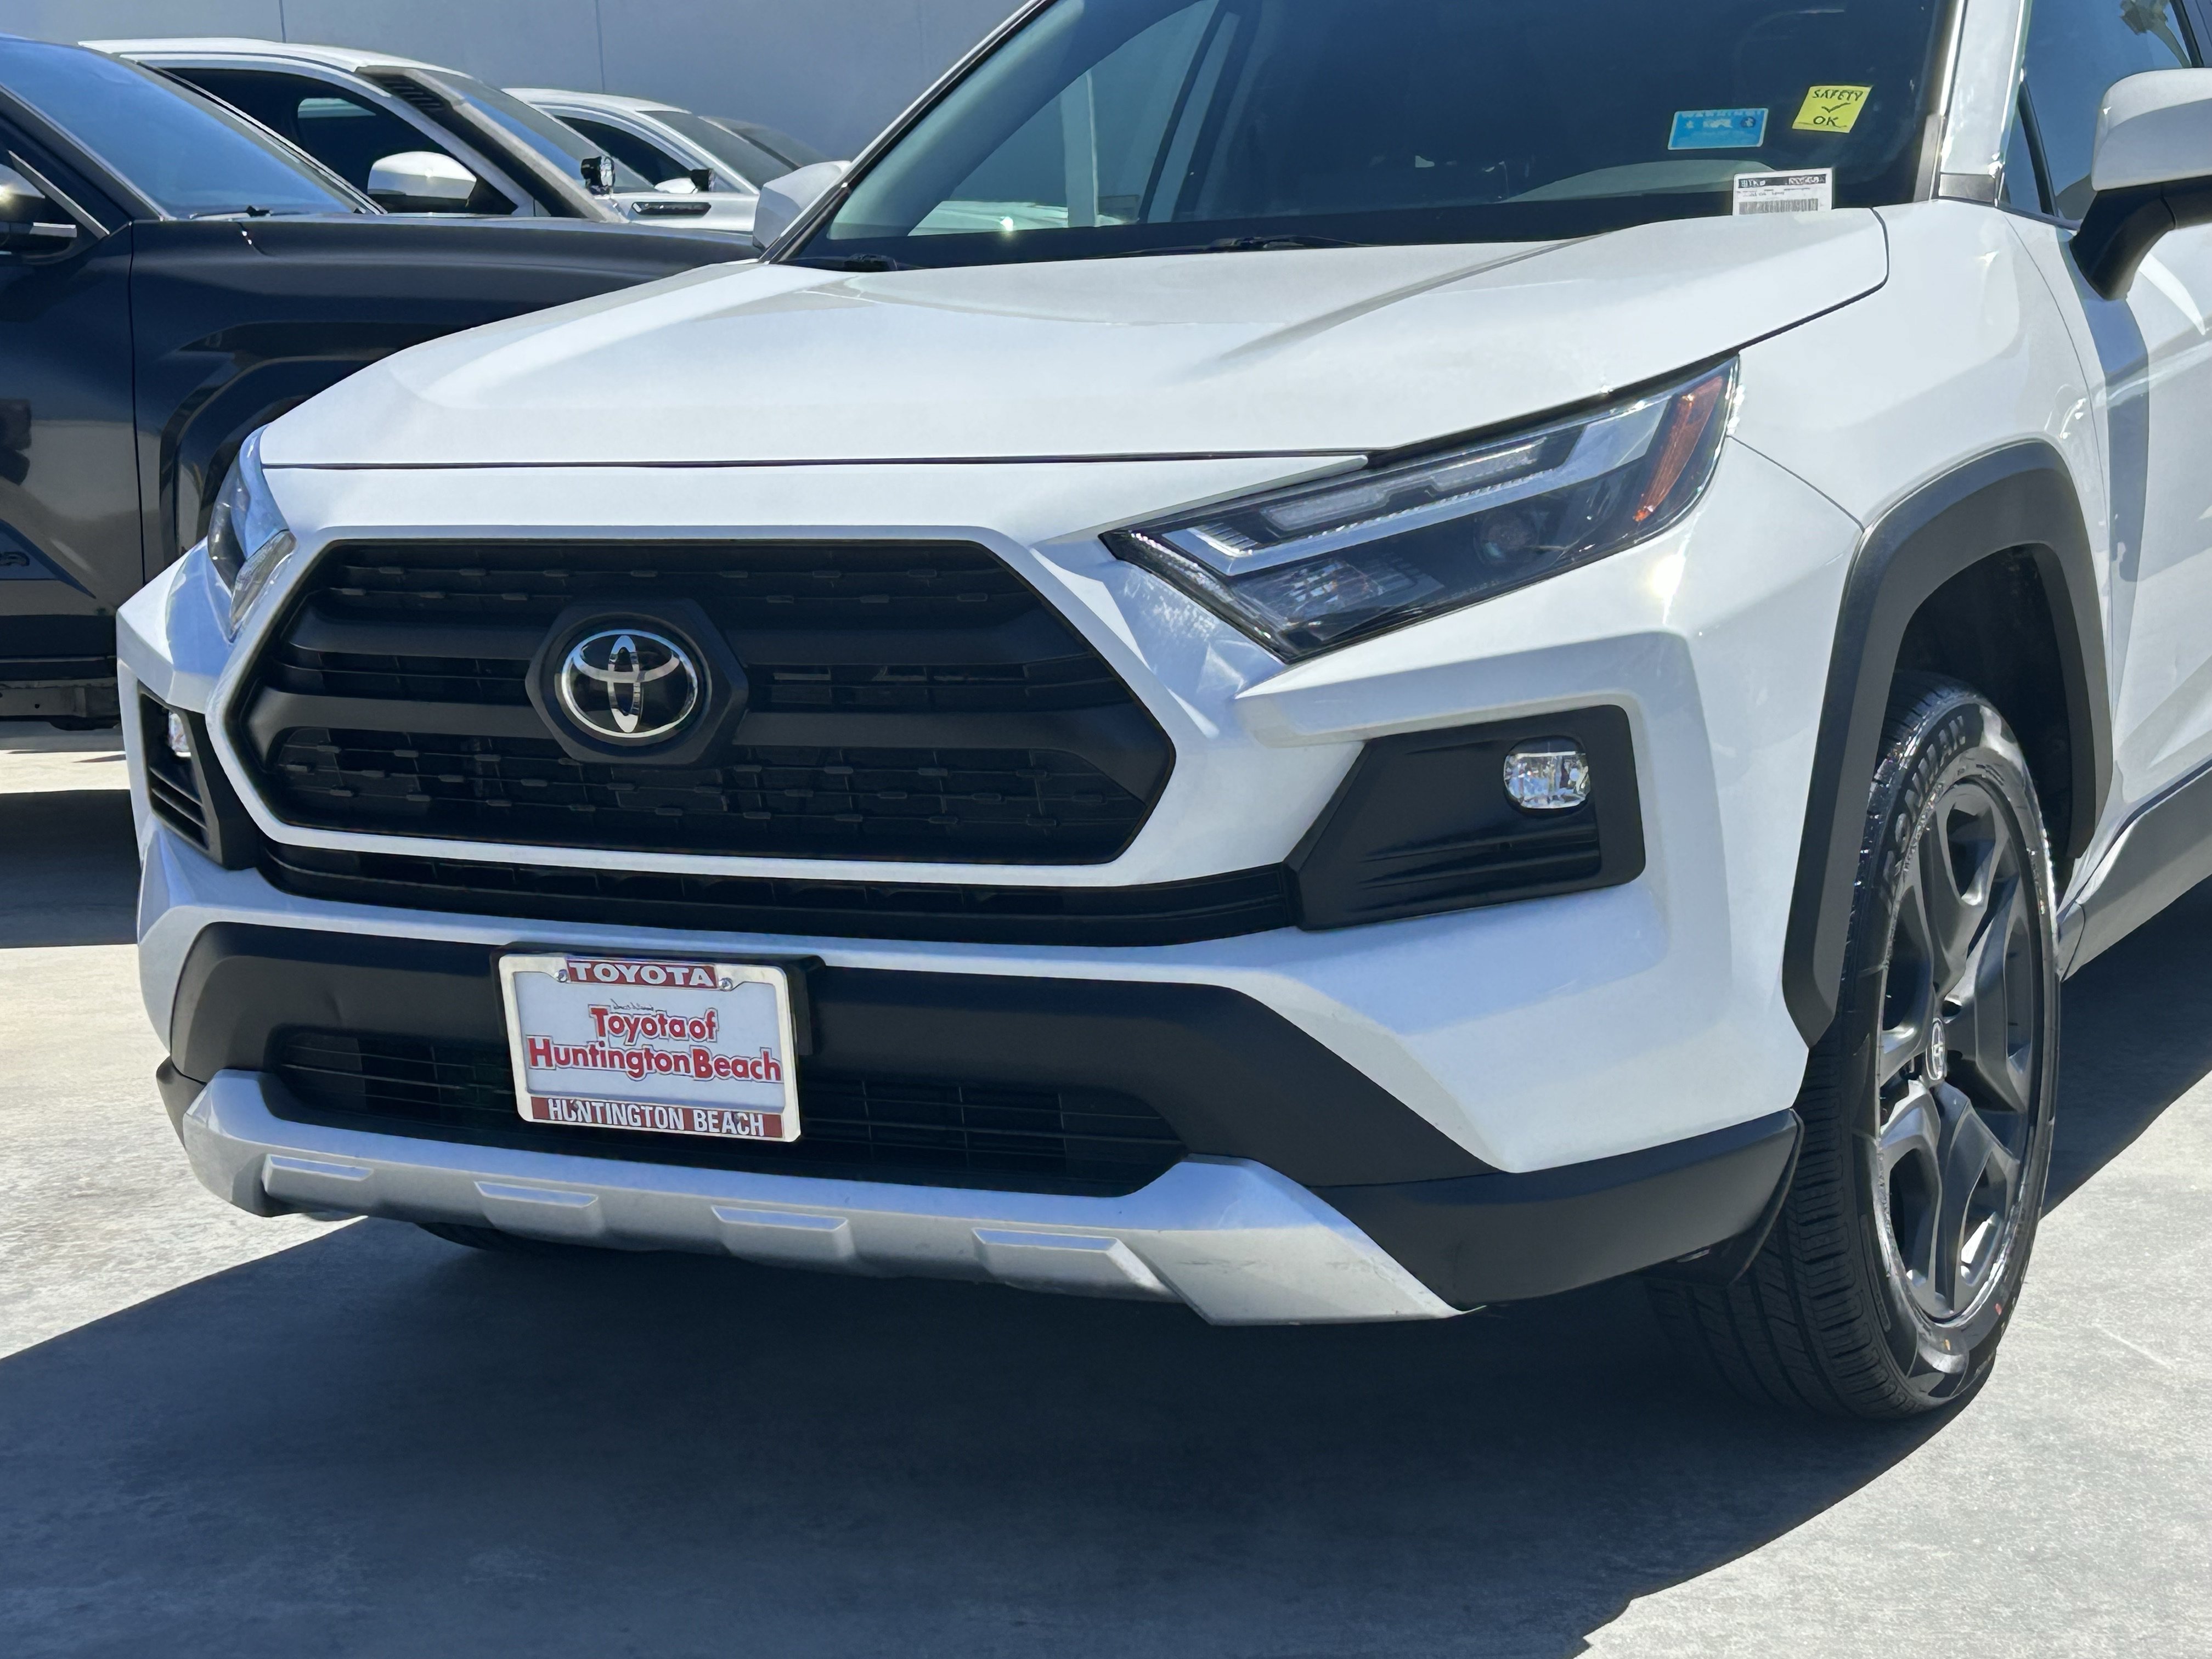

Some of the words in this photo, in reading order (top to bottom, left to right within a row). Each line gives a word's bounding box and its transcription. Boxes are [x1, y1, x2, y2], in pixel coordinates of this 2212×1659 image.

[1812, 89, 1864, 101] SAFETY
[1813, 115, 1843, 128] OK
[569, 962, 714, 987] TOYOTA
[548, 1098, 685, 1131] HUNTINGTON
[693, 1109, 765, 1137] BEACH
